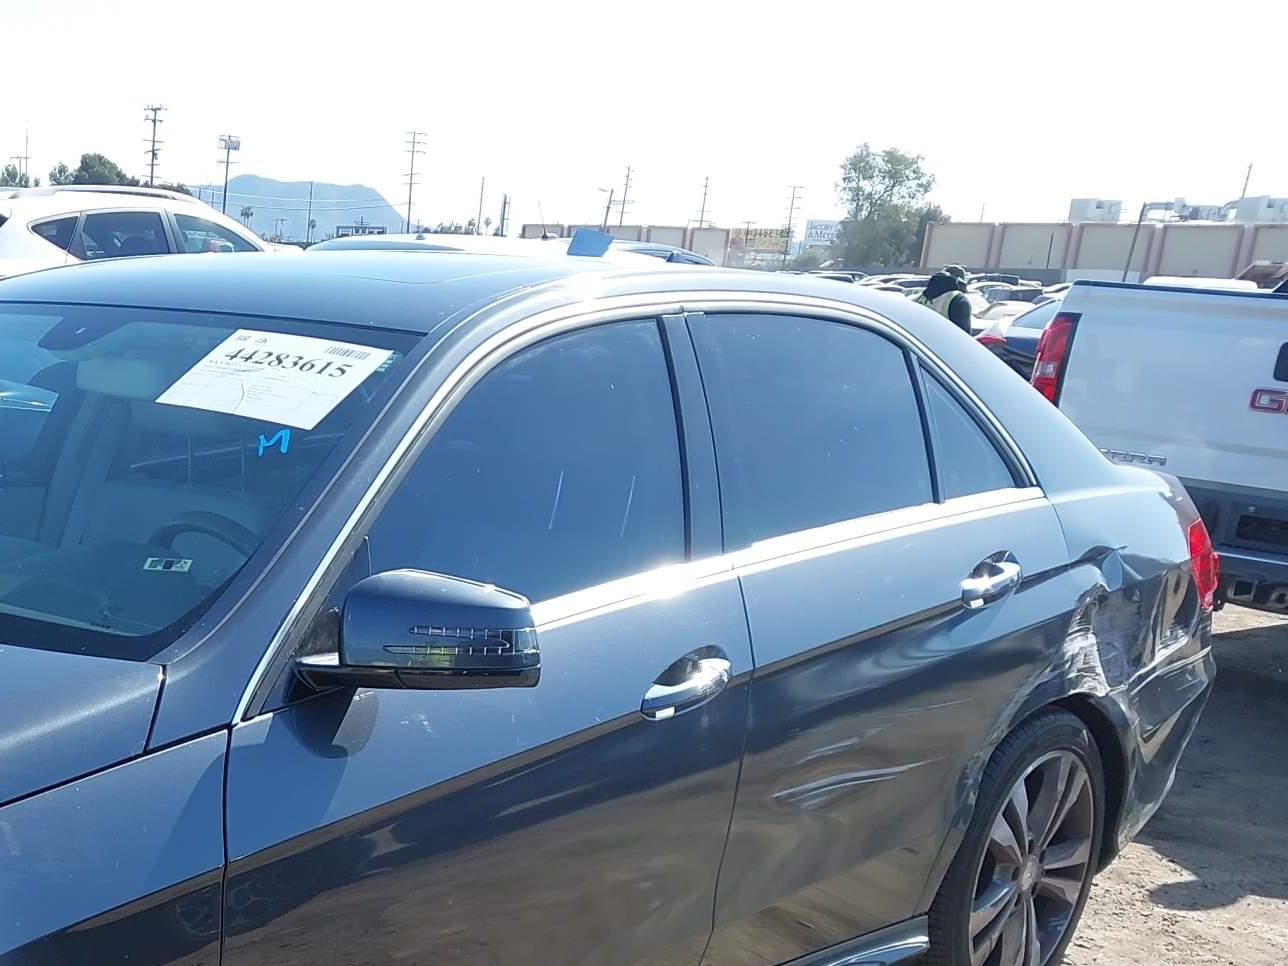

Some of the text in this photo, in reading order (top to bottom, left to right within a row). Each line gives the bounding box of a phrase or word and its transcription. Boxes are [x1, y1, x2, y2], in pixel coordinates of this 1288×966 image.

[225, 348, 353, 378] 44283615
[1249, 387, 1288, 415] G
[258, 428, 291, 457] M
